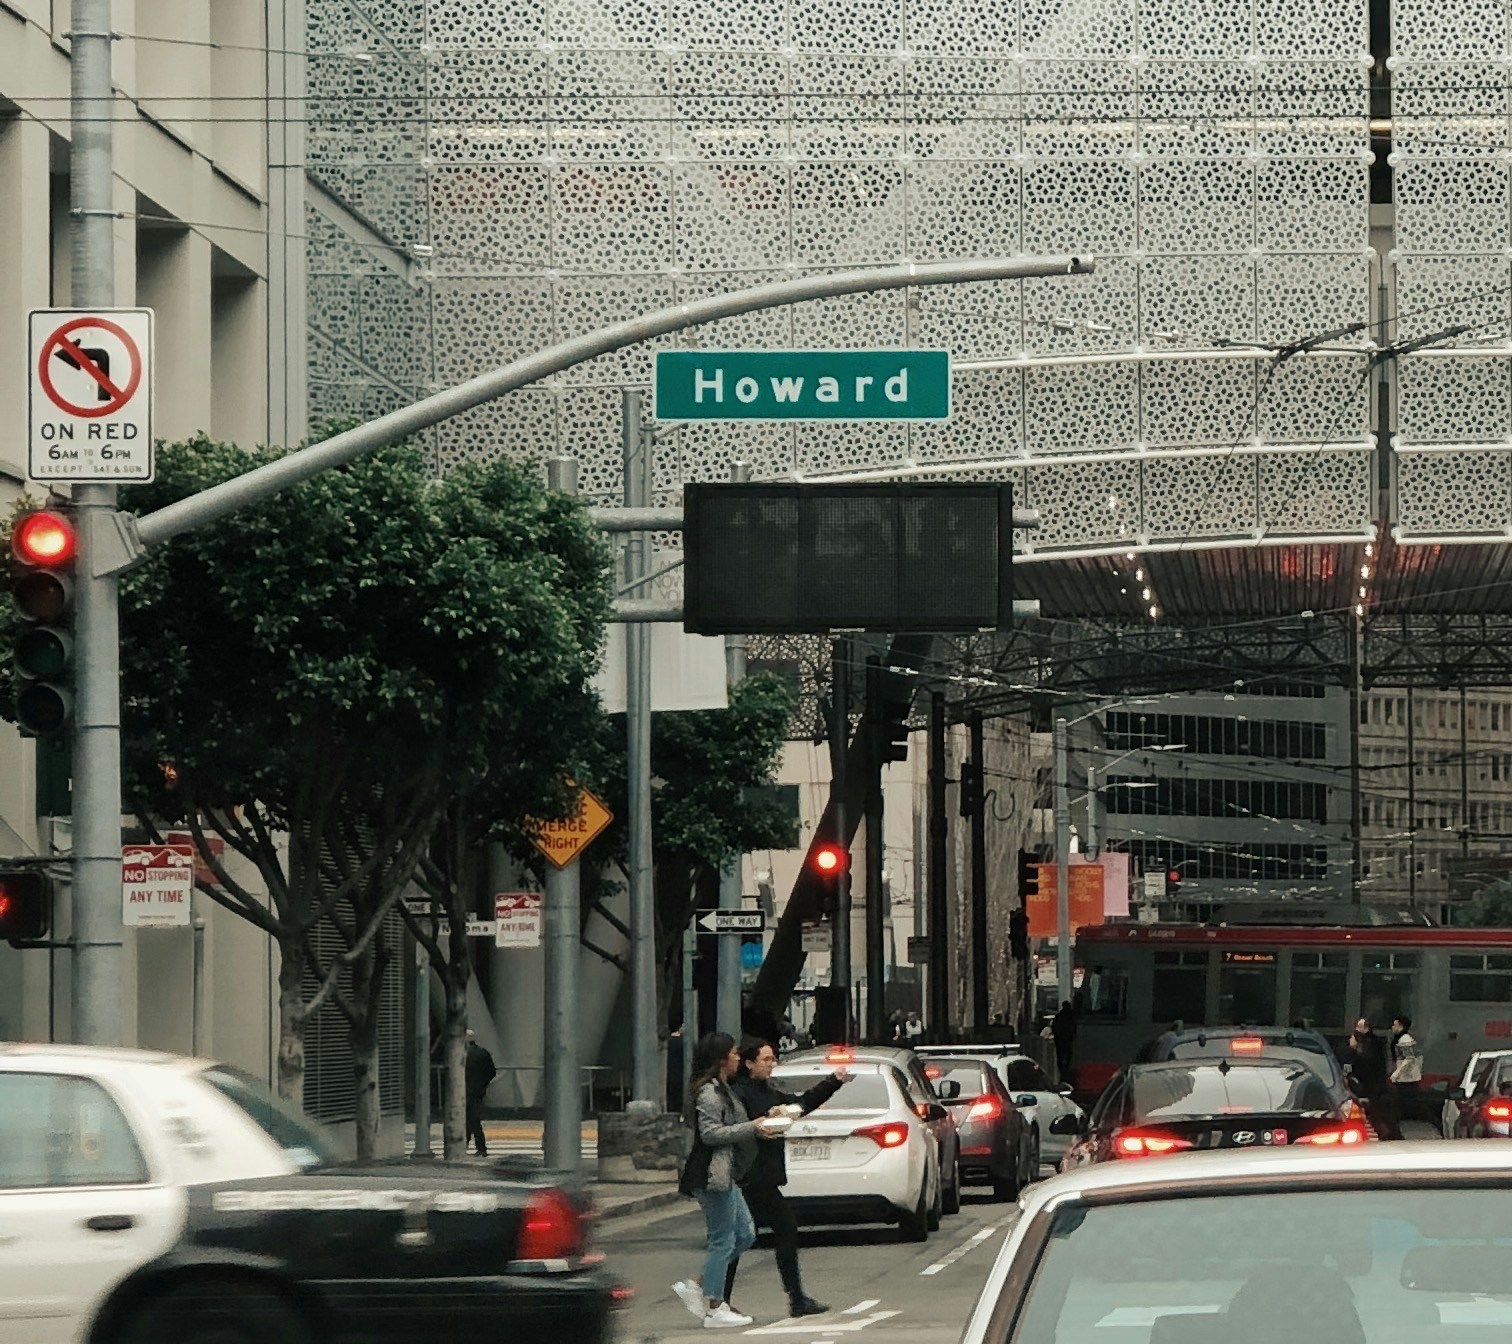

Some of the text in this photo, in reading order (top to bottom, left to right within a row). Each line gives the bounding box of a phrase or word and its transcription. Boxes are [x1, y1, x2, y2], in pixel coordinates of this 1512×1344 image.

[693, 367, 908, 403] Howard
[41, 423, 138, 440] ON RED
[48, 444, 131, 460] 6AM TO 6PM
[40, 465, 83, 474] EXCEPT
[93, 465, 110, 474] SAT
[123, 465, 142, 474] SUN
[544, 837, 580, 849] RIGHT
[124, 869, 189, 882] NO STOPPING
[130, 890, 184, 903] ANY TIME
[716, 915, 758, 926] ONE WAY
[442, 923, 489, 933] Noma
